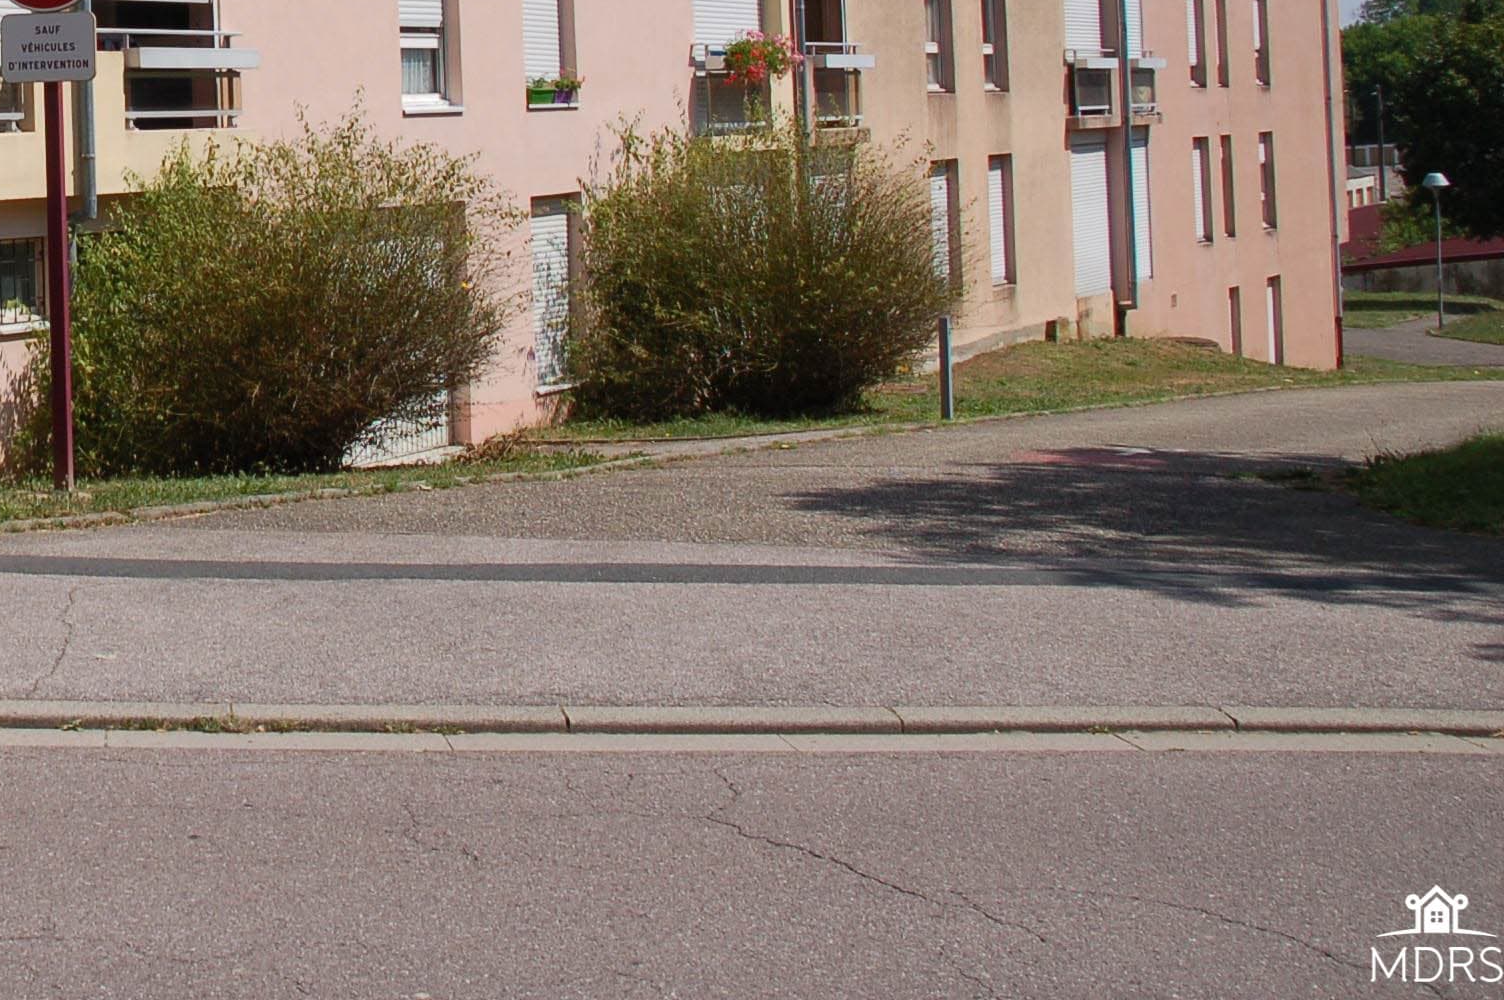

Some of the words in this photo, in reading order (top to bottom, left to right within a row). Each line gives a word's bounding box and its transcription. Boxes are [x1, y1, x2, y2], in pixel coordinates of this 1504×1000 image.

[35, 25, 61, 35] SAUF
[21, 42, 76, 53] VÉHICULES
[8, 59, 89, 71] D'INTERVENTION
